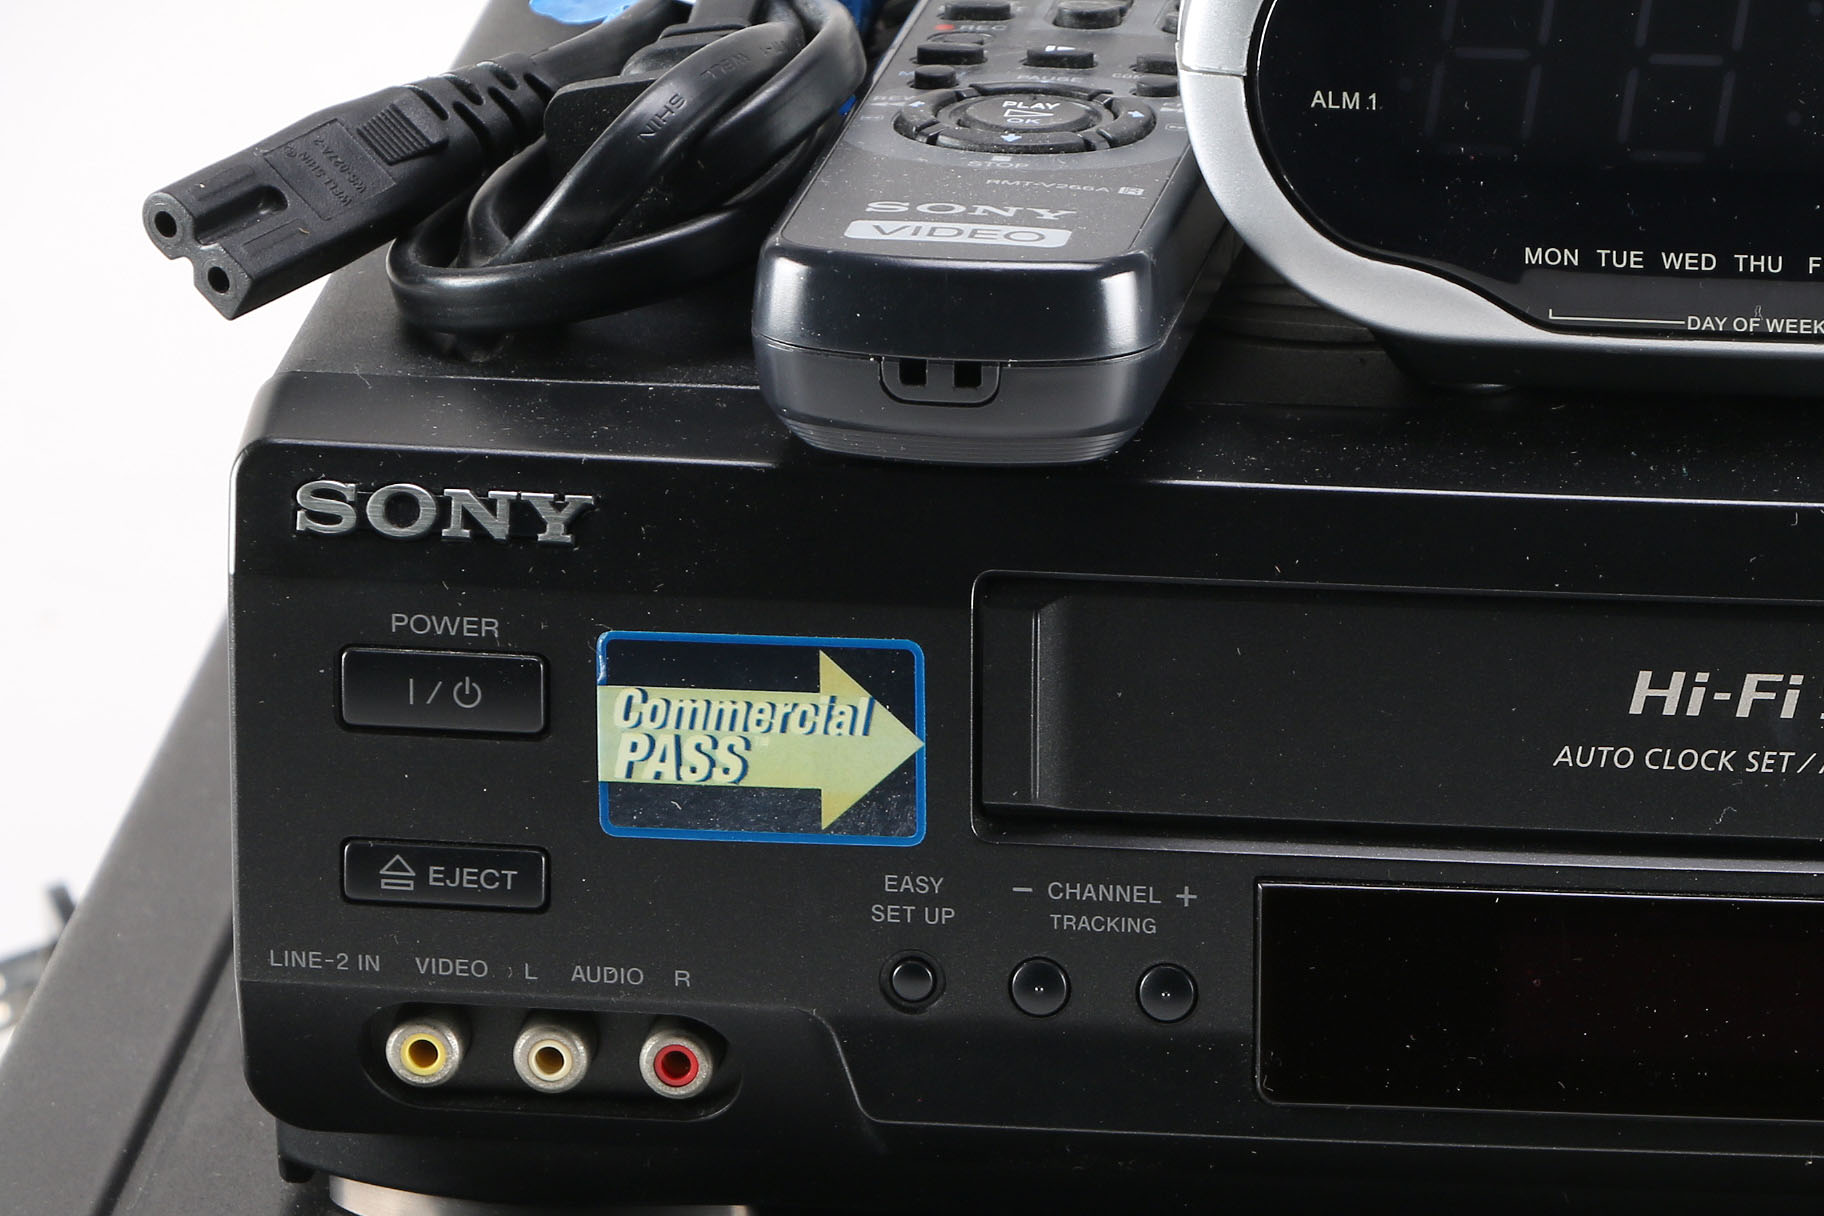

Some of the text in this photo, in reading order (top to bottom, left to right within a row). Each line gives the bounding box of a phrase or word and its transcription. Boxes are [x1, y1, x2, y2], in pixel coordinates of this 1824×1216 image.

[1001, 100, 1061, 111] PLAY
[1311, 91, 1378, 111] ALM 1
[1006, 117, 1041, 125] OK
[967, 160, 1031, 169] STOP
[865, 201, 1076, 220] SONY
[873, 225, 1045, 243] VIDEO
[1524, 247, 1579, 267] MON
[1597, 249, 1644, 269] TUE
[1662, 252, 1717, 271] WED
[1734, 254, 1783, 273] THU
[1687, 315, 1728, 332] DAY
[1733, 317, 1762, 333] OF
[295, 479, 596, 546] SONY
[391, 614, 499, 638] POWER
[1628, 670, 1804, 719] Hi-Fi
[614, 687, 877, 737] Commercial
[614, 733, 751, 784] PASS
[1553, 746, 1635, 768] AUTO
[1644, 748, 1736, 773] CLOCK
[427, 866, 518, 890] EJECT
[883, 875, 944, 894] EASY
[1047, 882, 1162, 904] CHANNEL
[871, 905, 956, 925] SET UP
[1050, 914, 1158, 934] TRACKING
[269, 950, 692, 988] LINE-2 IN VIDEO L AUDIO R
